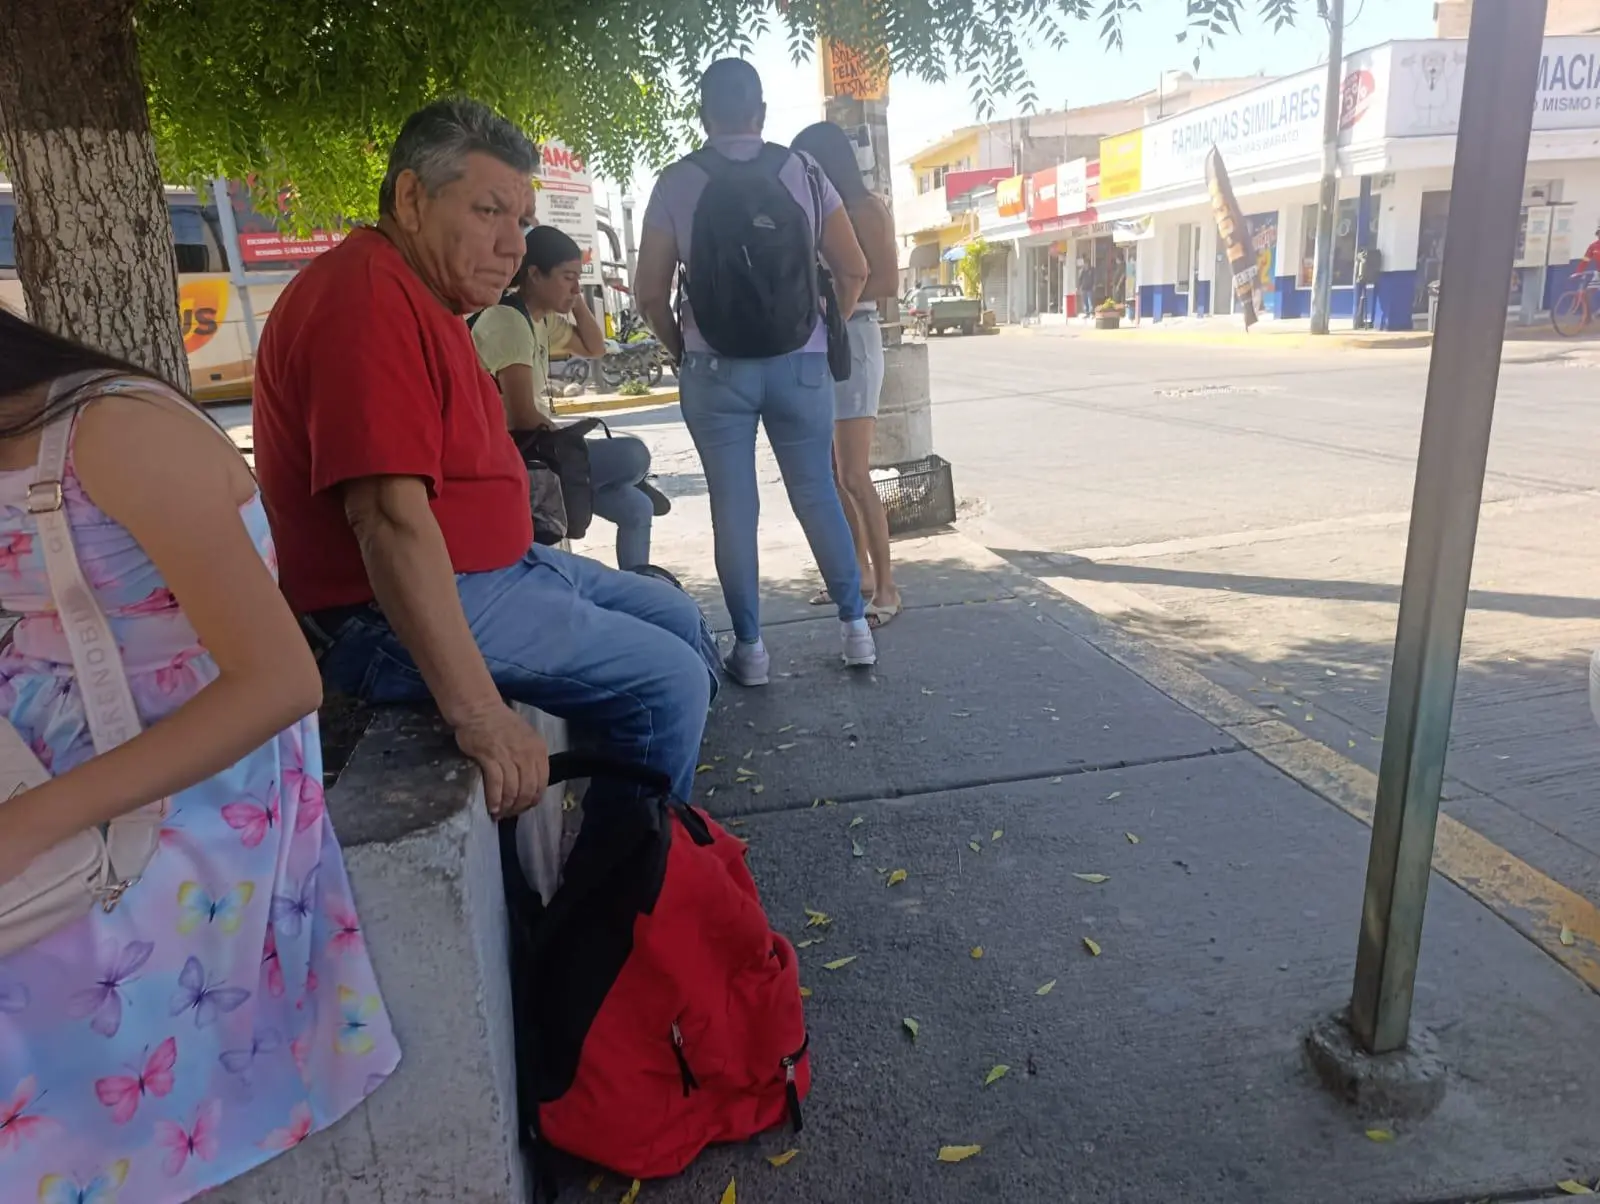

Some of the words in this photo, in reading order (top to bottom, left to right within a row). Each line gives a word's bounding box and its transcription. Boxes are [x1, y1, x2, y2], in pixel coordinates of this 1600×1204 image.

[1172, 110, 1239, 155] FARMACIAS
[1242, 84, 1321, 137] SIMILARES
[1542, 96, 1592, 112] MISMO
